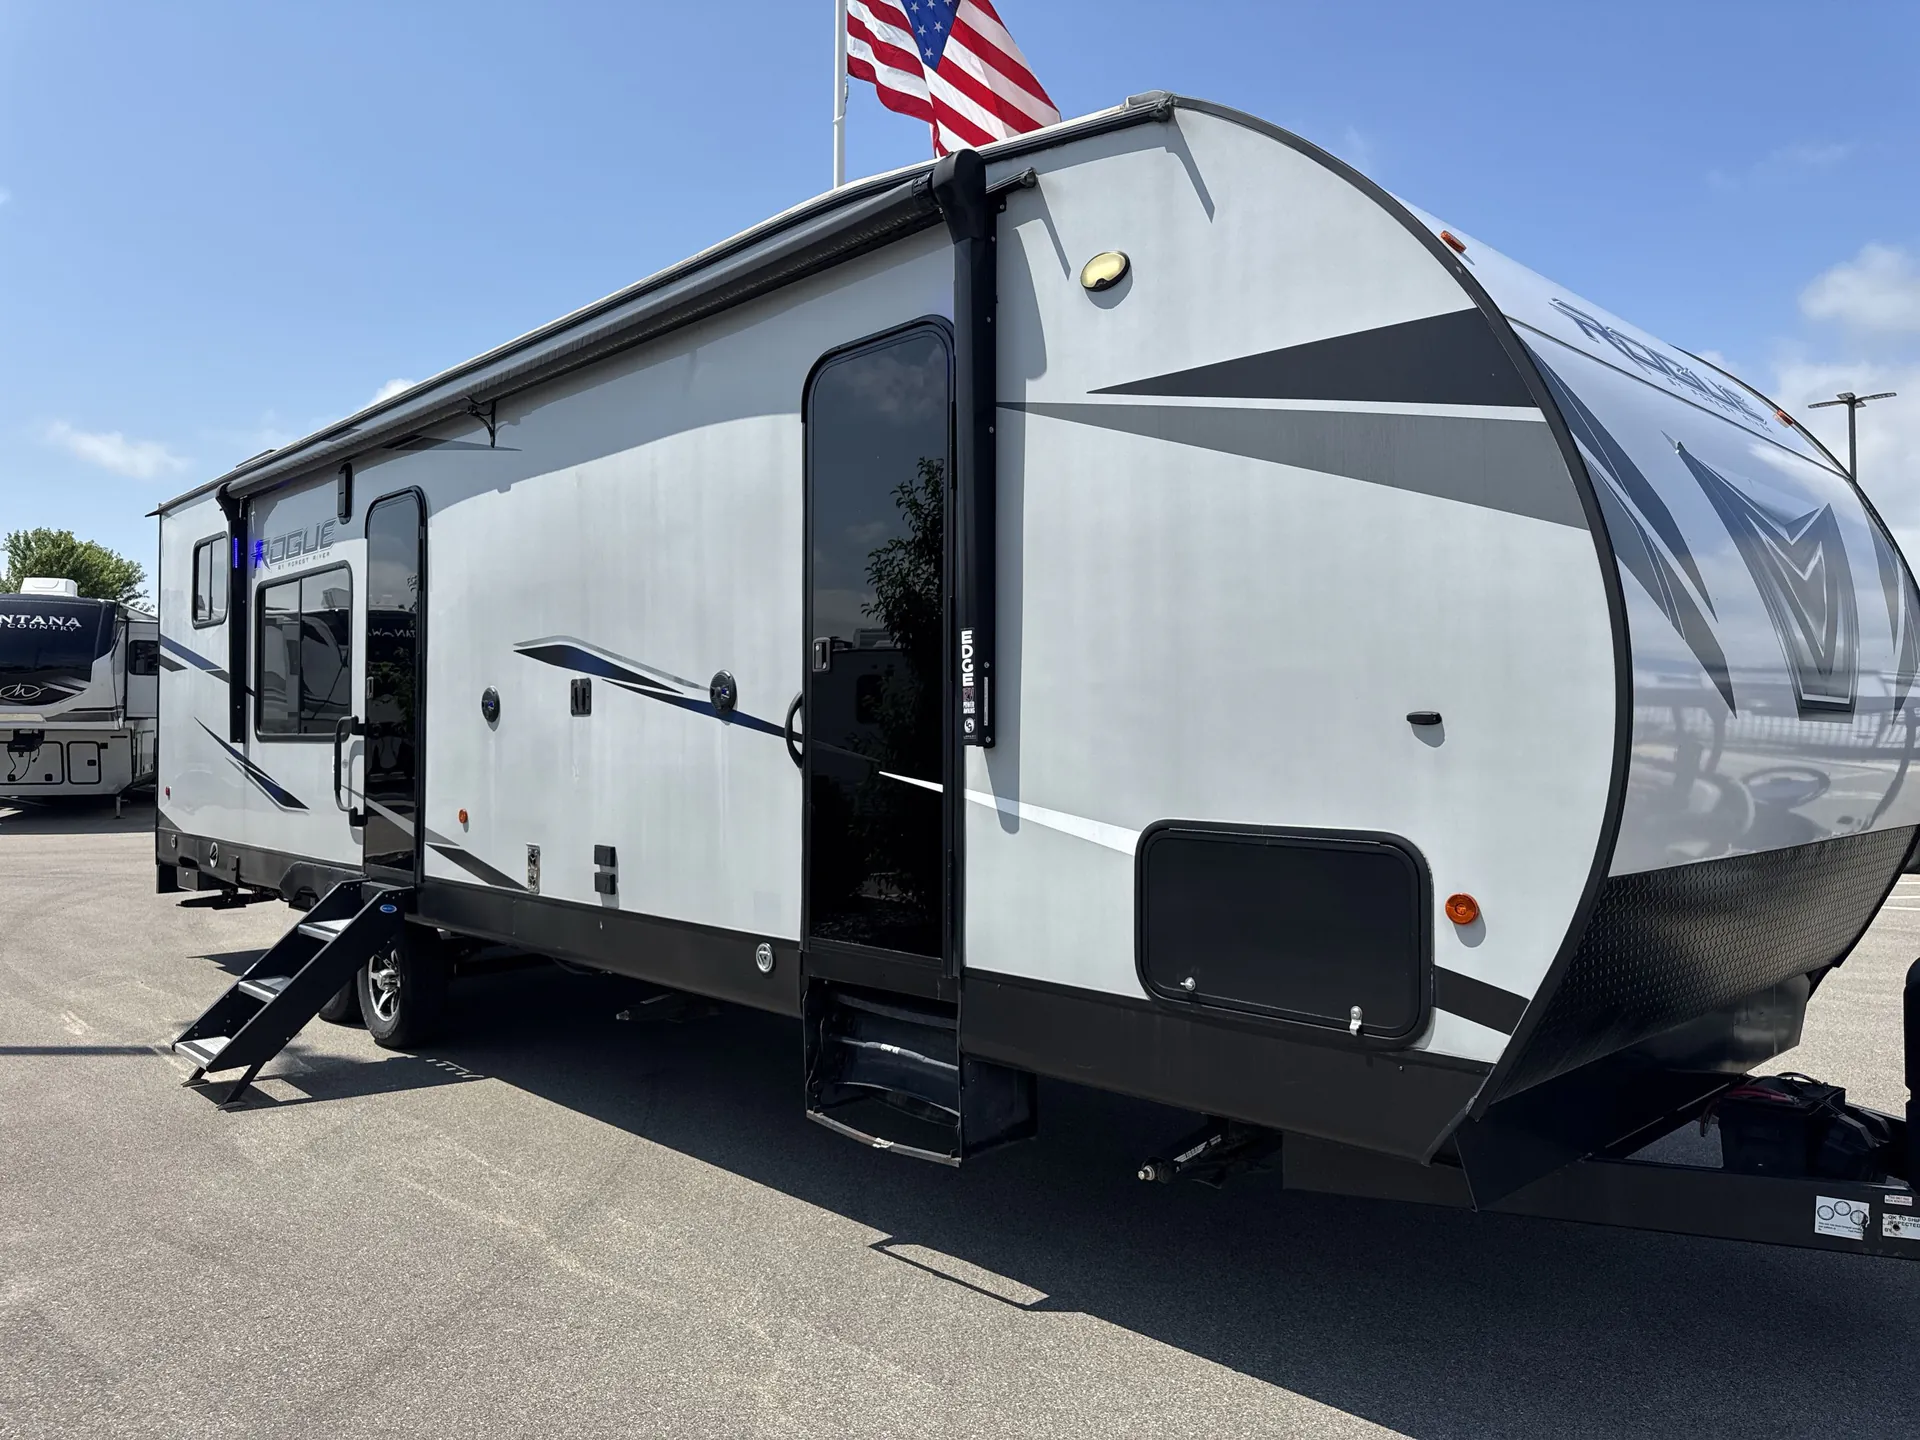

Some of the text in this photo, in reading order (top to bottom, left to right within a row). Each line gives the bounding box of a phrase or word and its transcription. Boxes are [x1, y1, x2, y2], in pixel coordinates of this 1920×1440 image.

[251, 517, 337, 572] ROGUE
[7, 623, 76, 632] COUNTRY
[961, 630, 974, 687] EDGE
